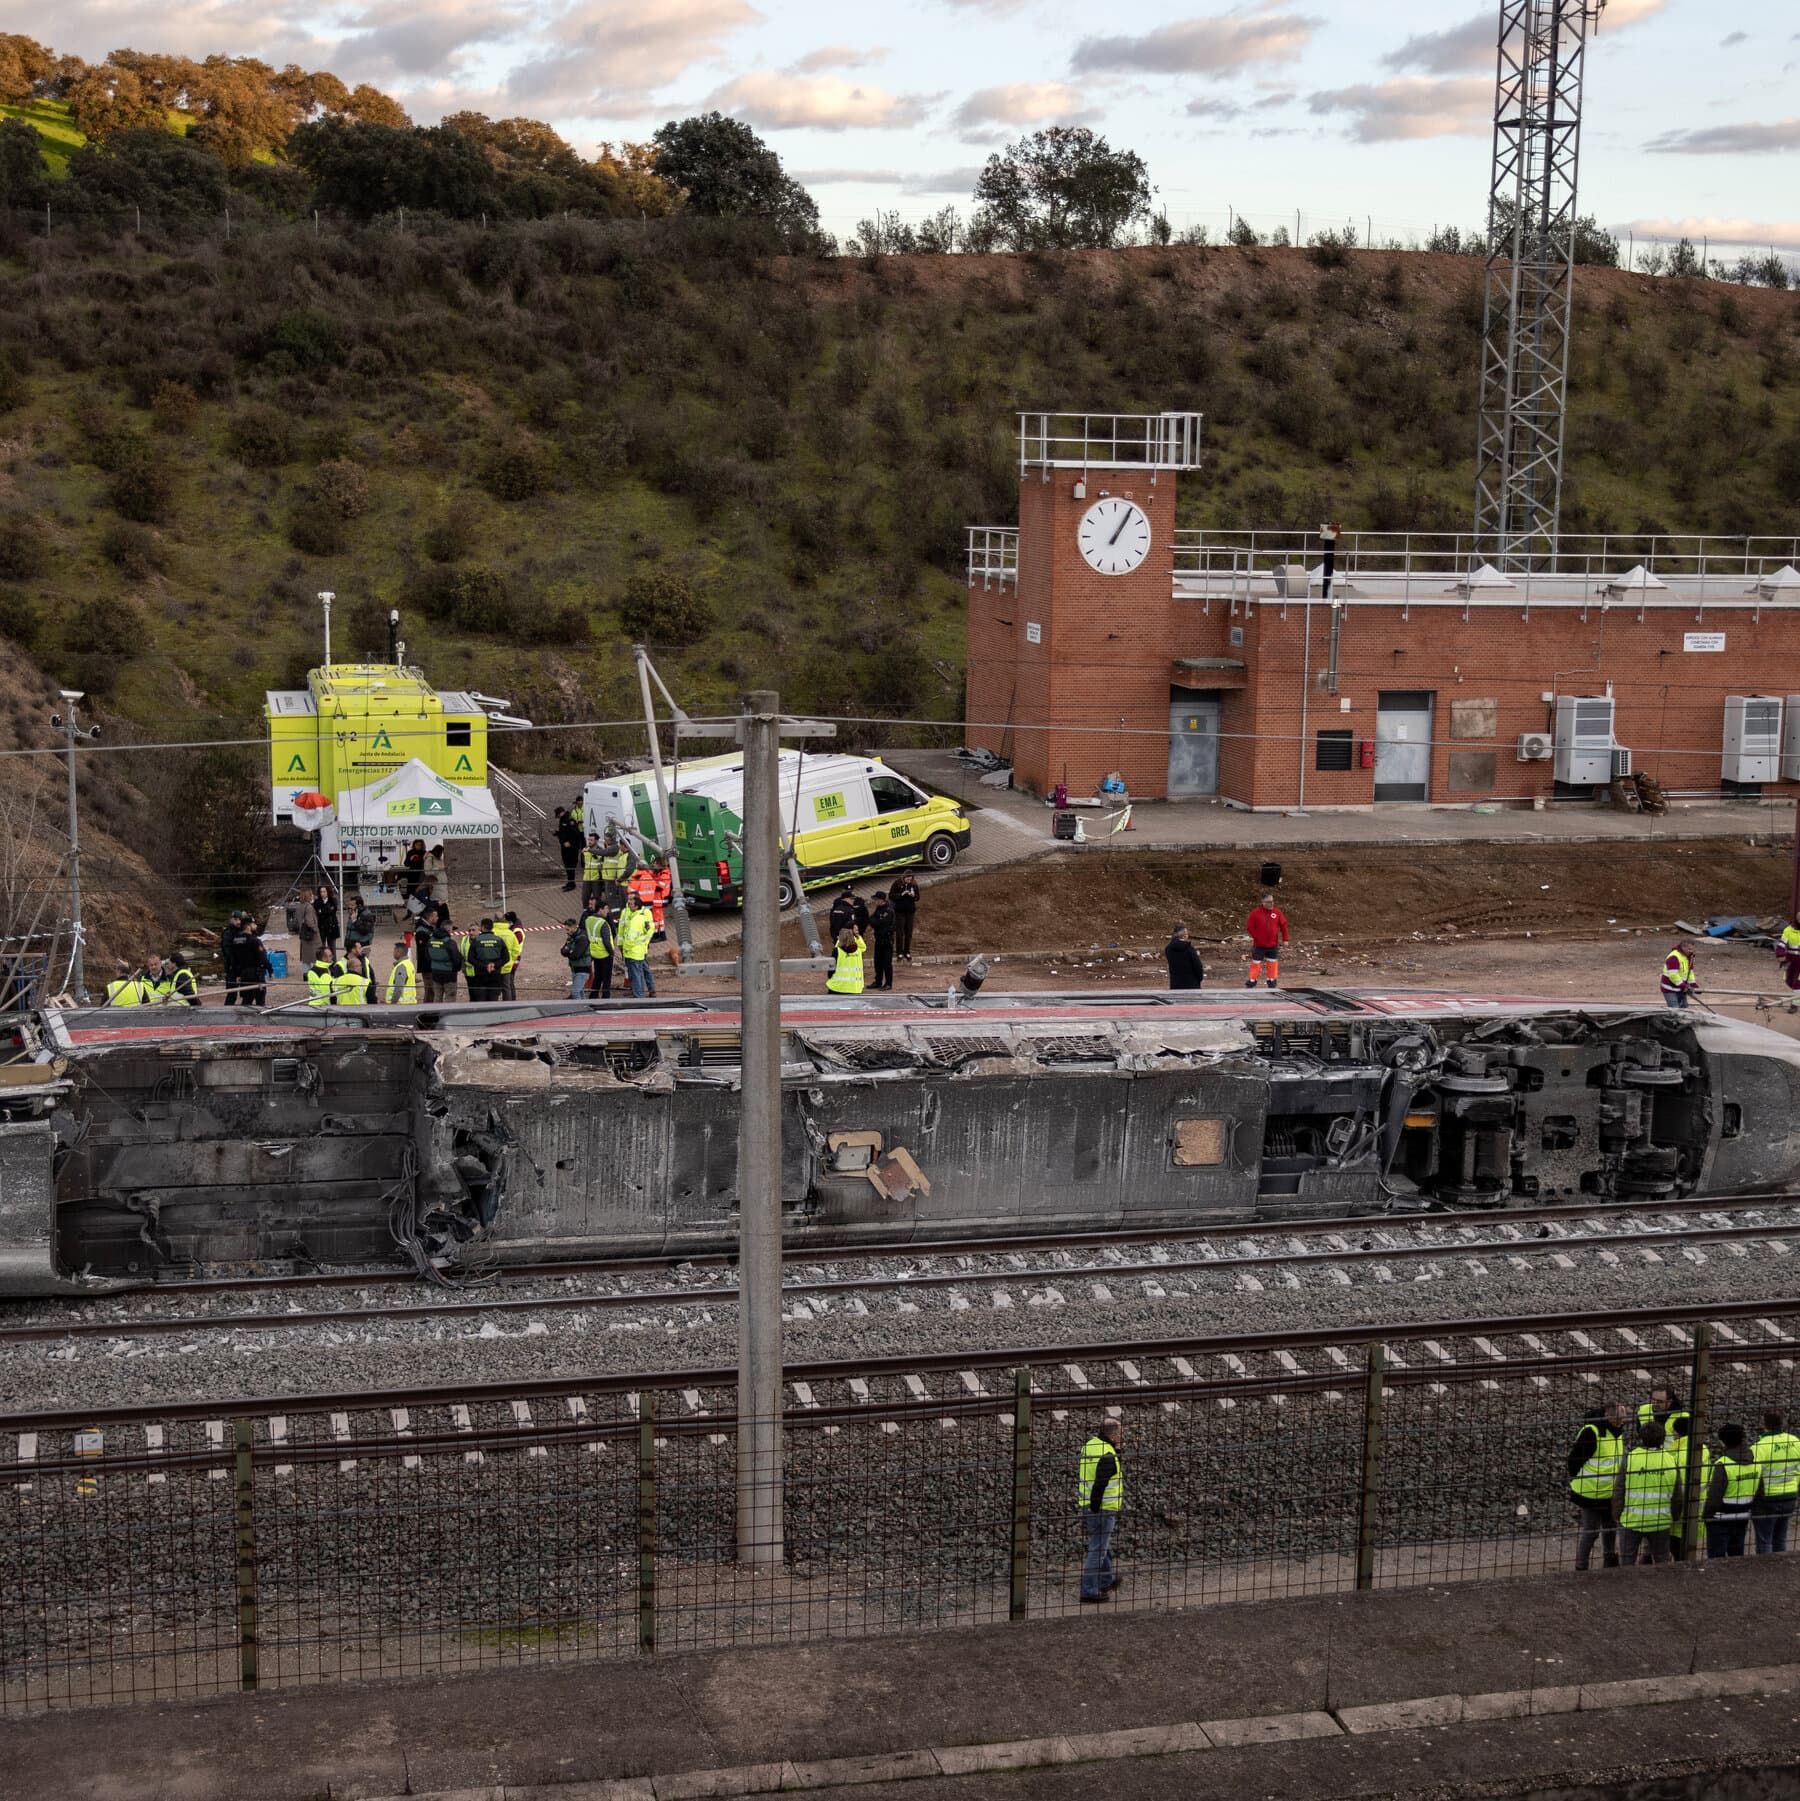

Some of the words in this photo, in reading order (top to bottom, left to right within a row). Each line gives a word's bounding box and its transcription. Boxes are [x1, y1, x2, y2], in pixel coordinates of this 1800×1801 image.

[820, 796, 838, 809] EMA
[340, 826, 378, 837] PUESTO
[380, 826, 394, 836] DE
[397, 825, 438, 836] MANDO
[441, 824, 499, 835] AVANZADO
[891, 824, 910, 839] GREA
